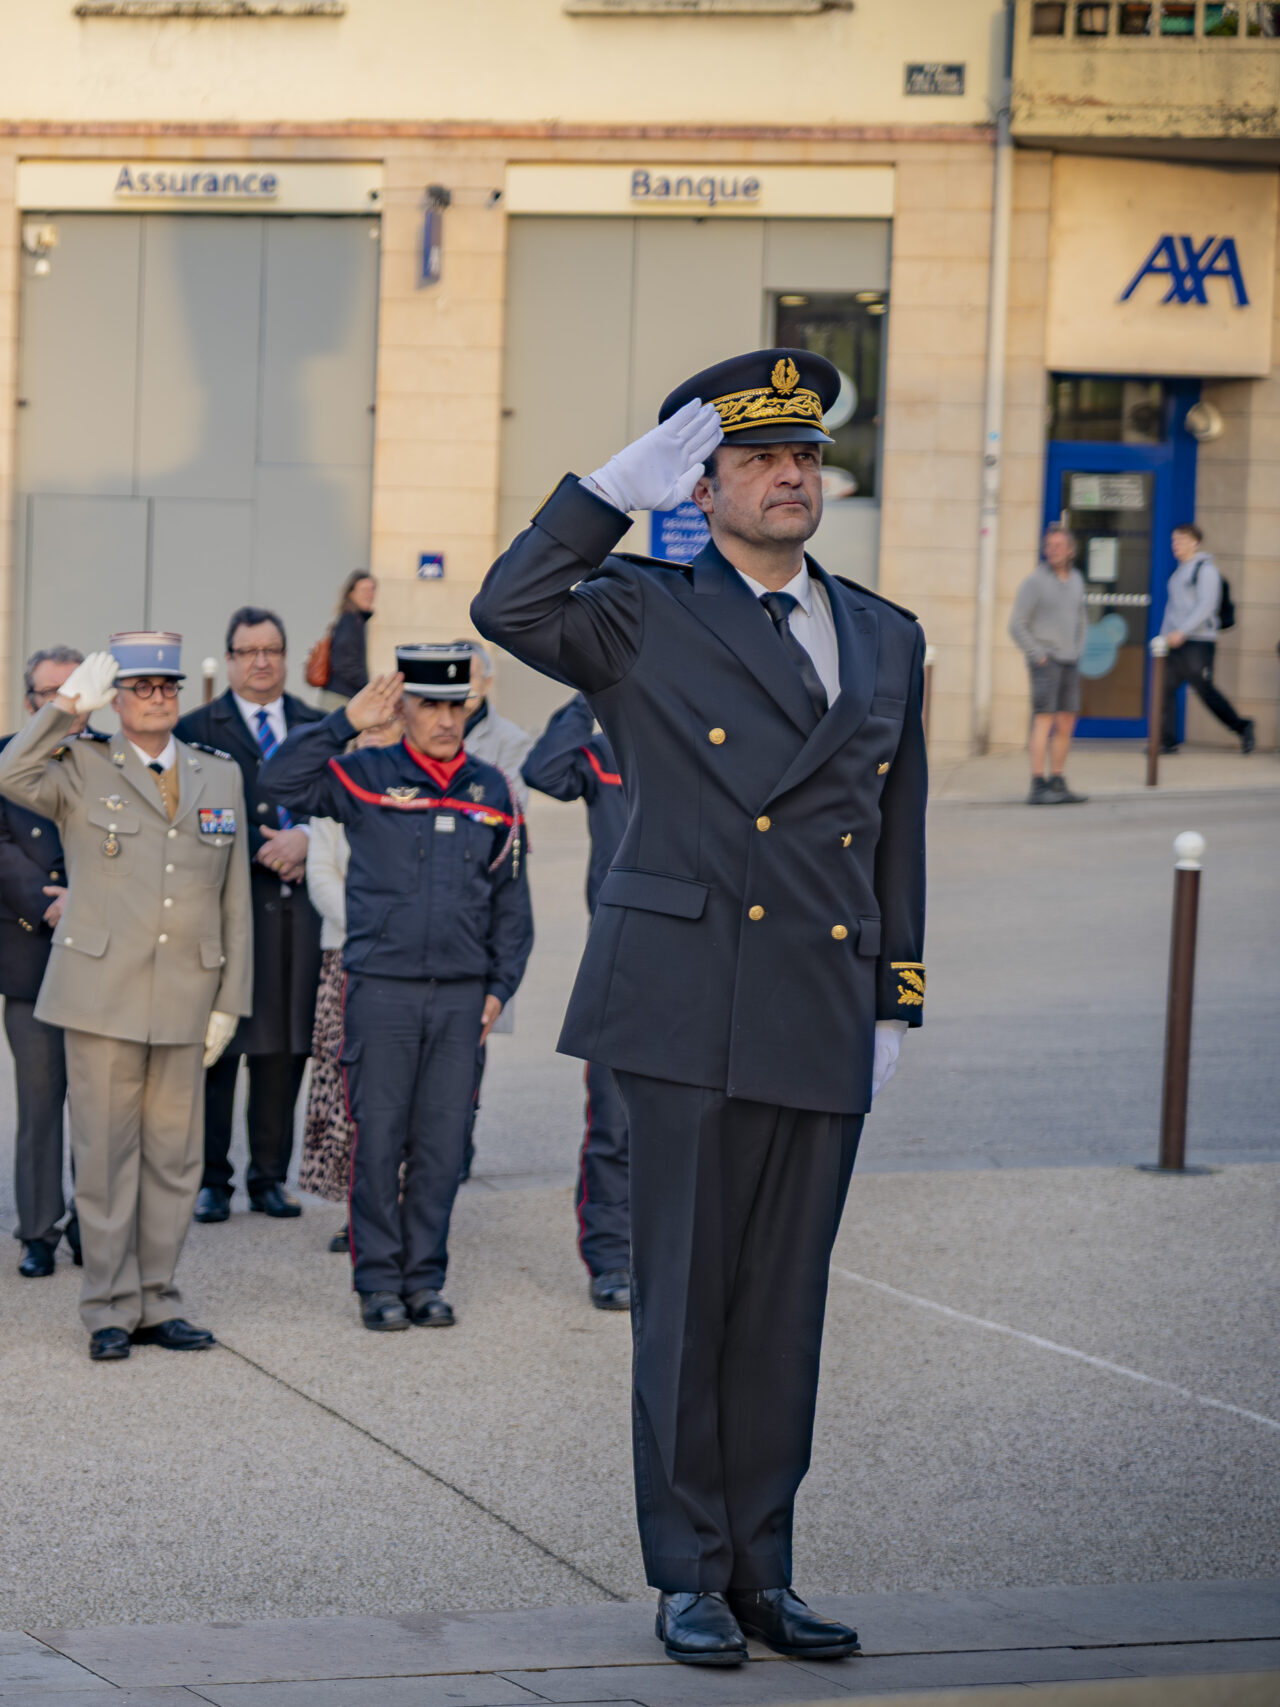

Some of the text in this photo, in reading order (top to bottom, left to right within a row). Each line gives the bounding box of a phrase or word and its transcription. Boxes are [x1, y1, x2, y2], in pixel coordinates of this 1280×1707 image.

[115, 166, 279, 194] Assurance
[631, 169, 762, 205] Banque
[1121, 234, 1250, 306] AXA
